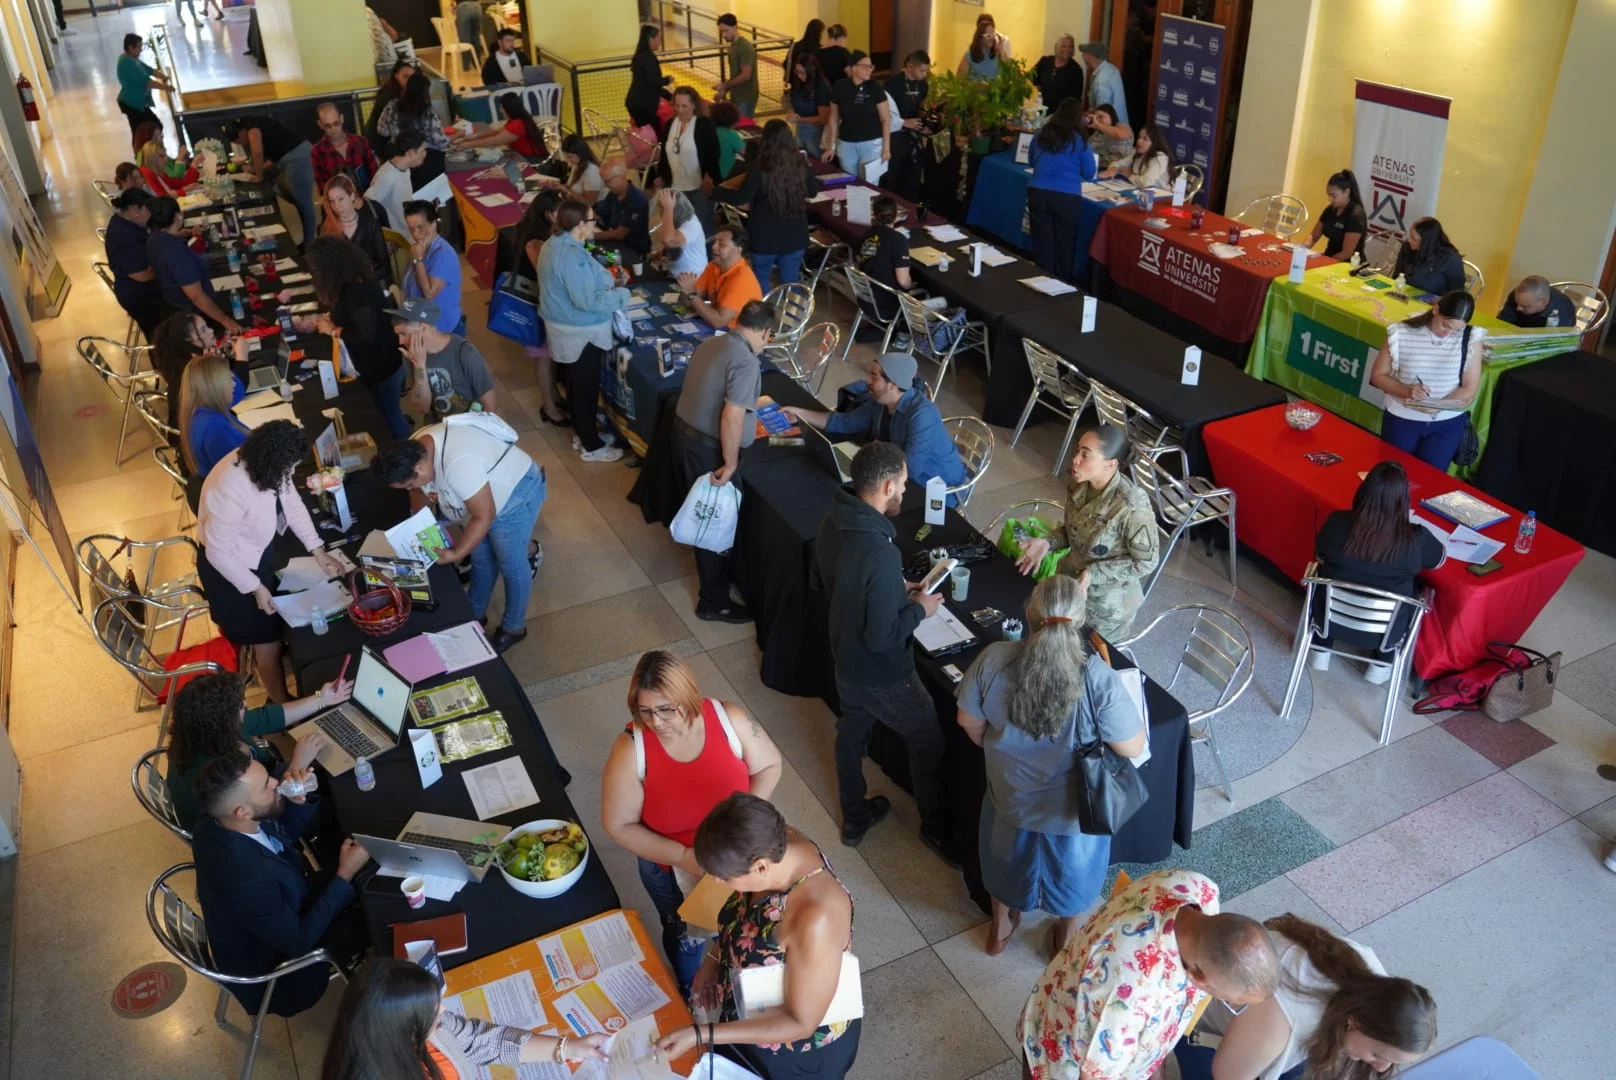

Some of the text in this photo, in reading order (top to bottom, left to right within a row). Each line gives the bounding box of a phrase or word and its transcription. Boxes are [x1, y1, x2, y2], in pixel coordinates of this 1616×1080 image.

[1371, 166, 1415, 185] UNIVERSITY
[1372, 154, 1415, 176] ATENAS
[1164, 262, 1218, 295] UNIVERSITY
[1166, 246, 1221, 284] ATENAS
[1300, 331, 1360, 378] 1 First
